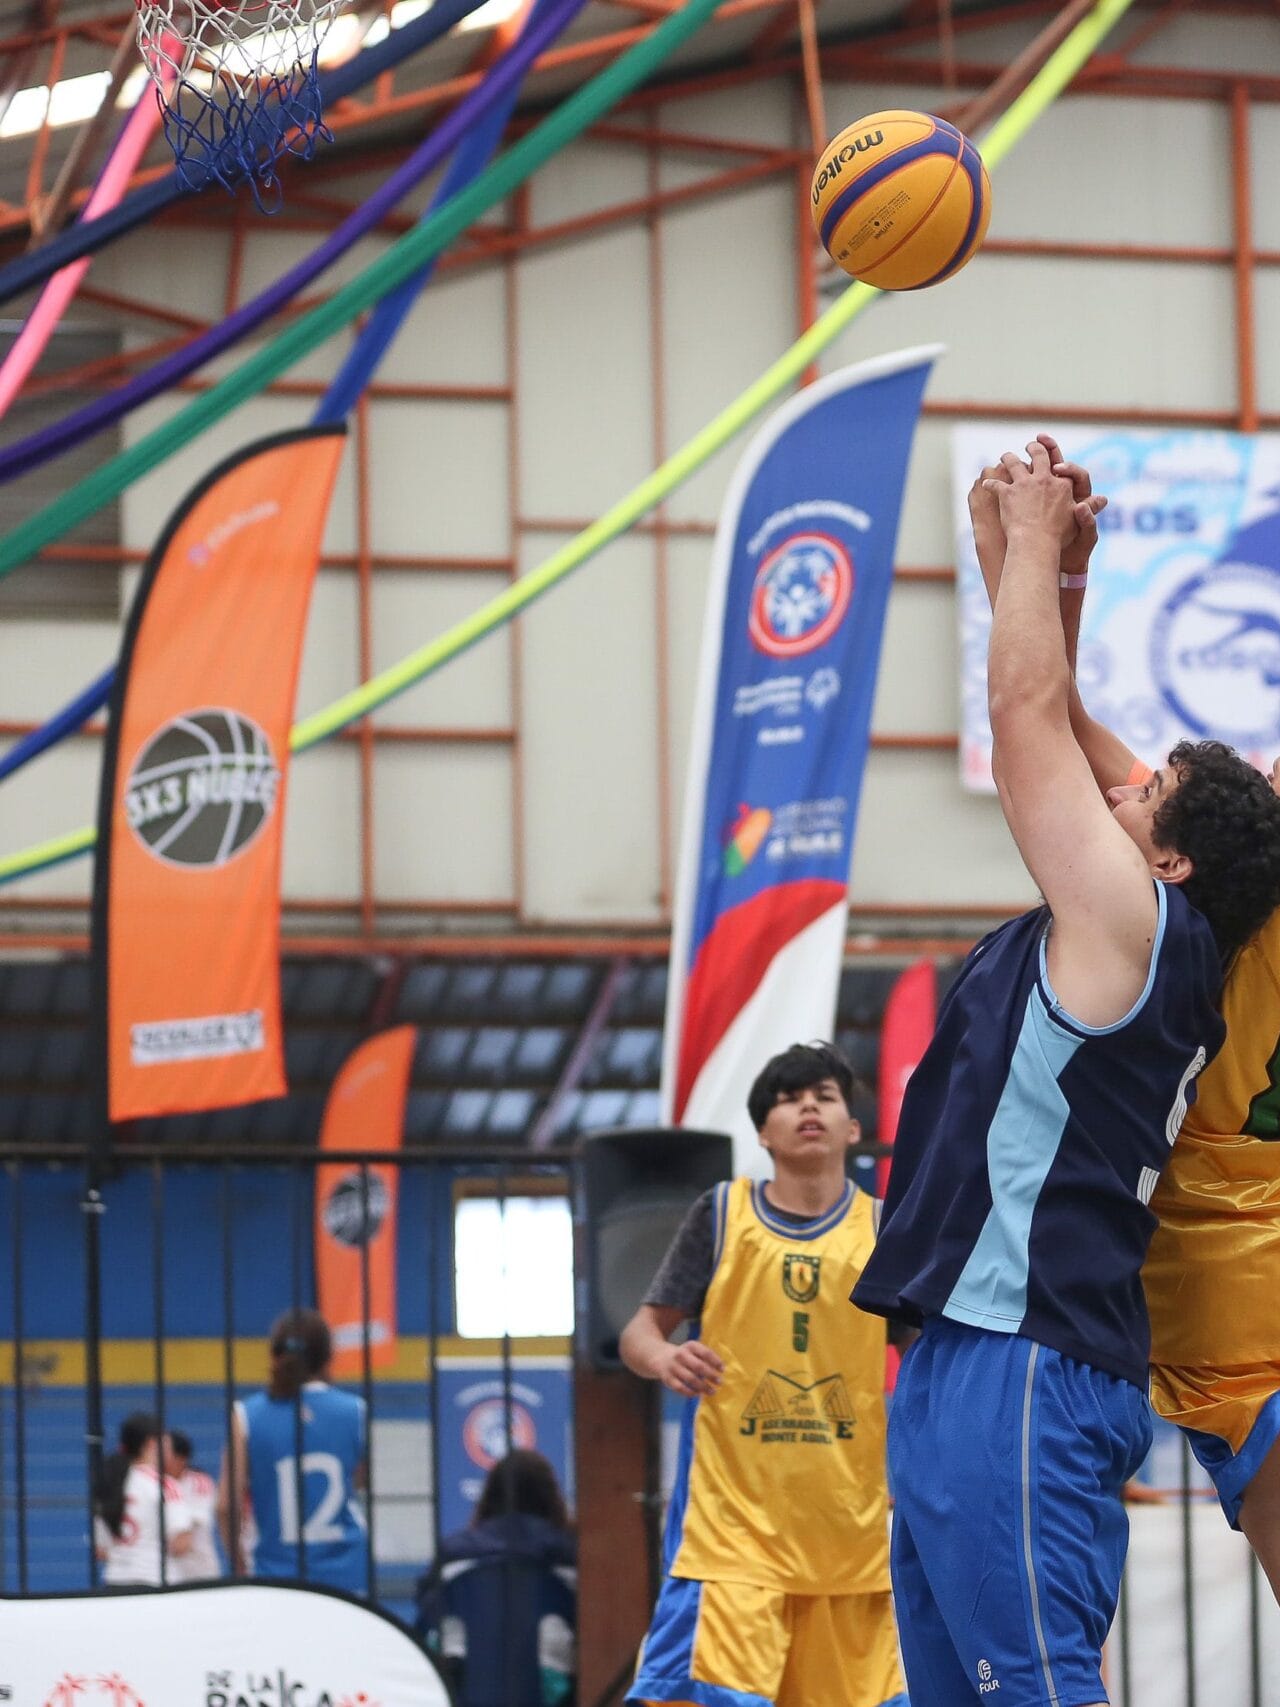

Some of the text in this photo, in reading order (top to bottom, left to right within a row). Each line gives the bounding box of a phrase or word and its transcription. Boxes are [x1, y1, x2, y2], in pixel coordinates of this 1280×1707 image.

[812, 130, 884, 205] molten
[793, 1311, 809, 1352] 5
[276, 1452, 345, 1545] 12
[979, 1679, 1000, 1694] FOUR
